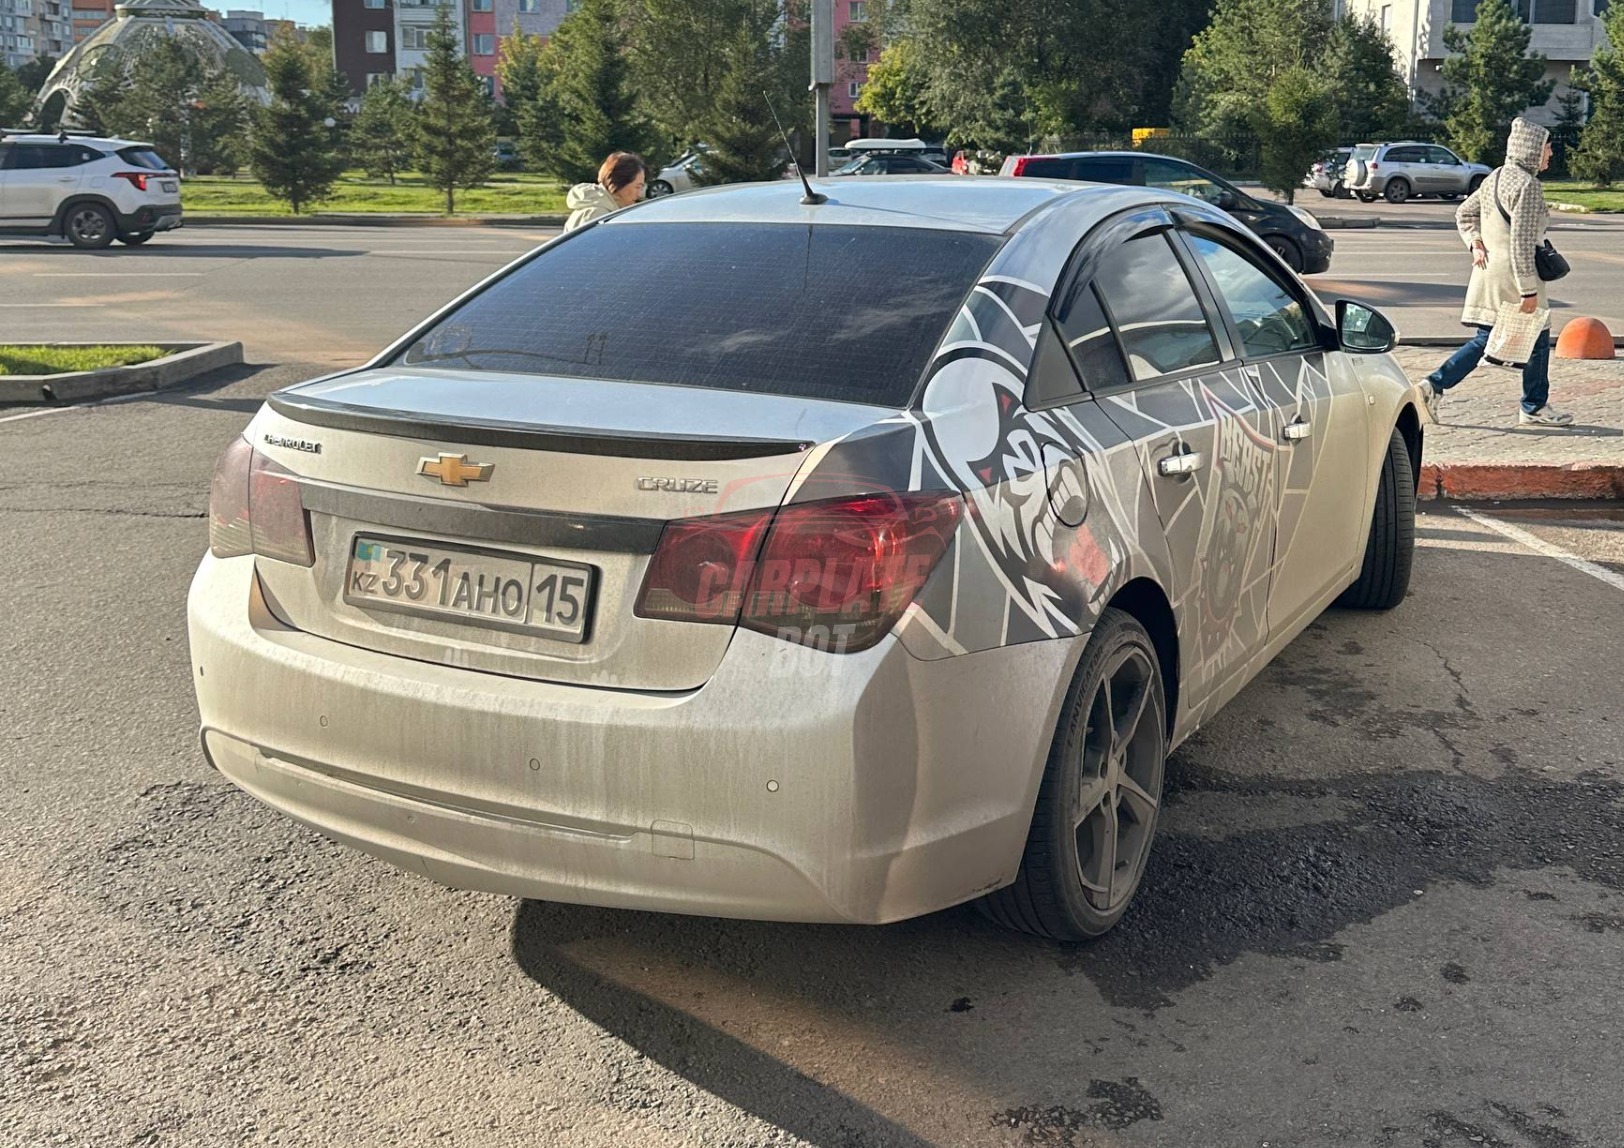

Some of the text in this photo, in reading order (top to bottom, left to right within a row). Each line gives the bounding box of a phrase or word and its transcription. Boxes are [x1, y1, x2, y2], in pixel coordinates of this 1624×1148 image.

[637, 476, 718, 494] CRUZE
[352, 571, 380, 594] KZ
[536, 573, 585, 626] 15
